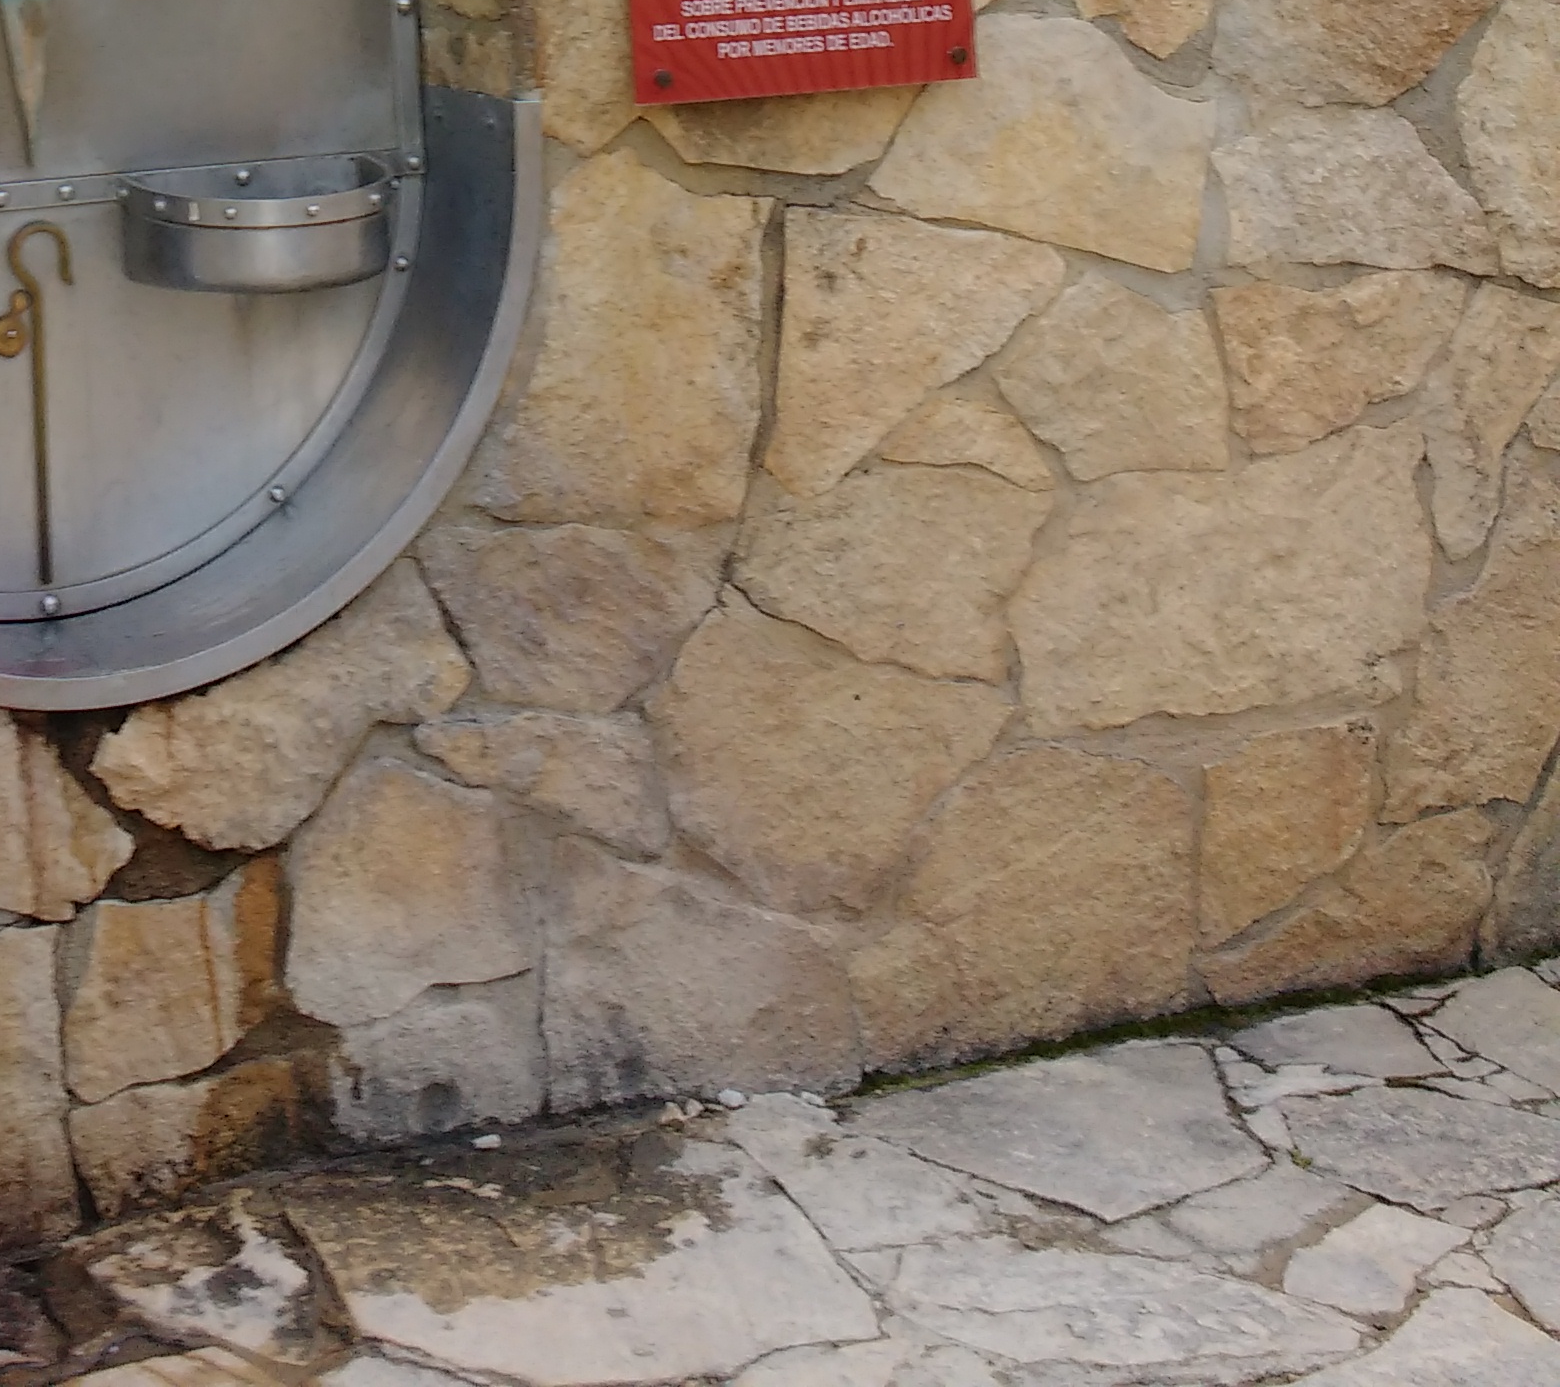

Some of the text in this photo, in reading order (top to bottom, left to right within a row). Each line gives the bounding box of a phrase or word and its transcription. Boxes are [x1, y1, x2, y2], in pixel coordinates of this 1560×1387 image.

[652, 24, 685, 41] DEL
[685, 18, 761, 39] CONSUMO
[762, 16, 785, 33] DE
[785, 11, 851, 32] BEBIDAS
[717, 41, 751, 58] POR
[751, 35, 825, 56] MENORES
[825, 33, 848, 51] DE
